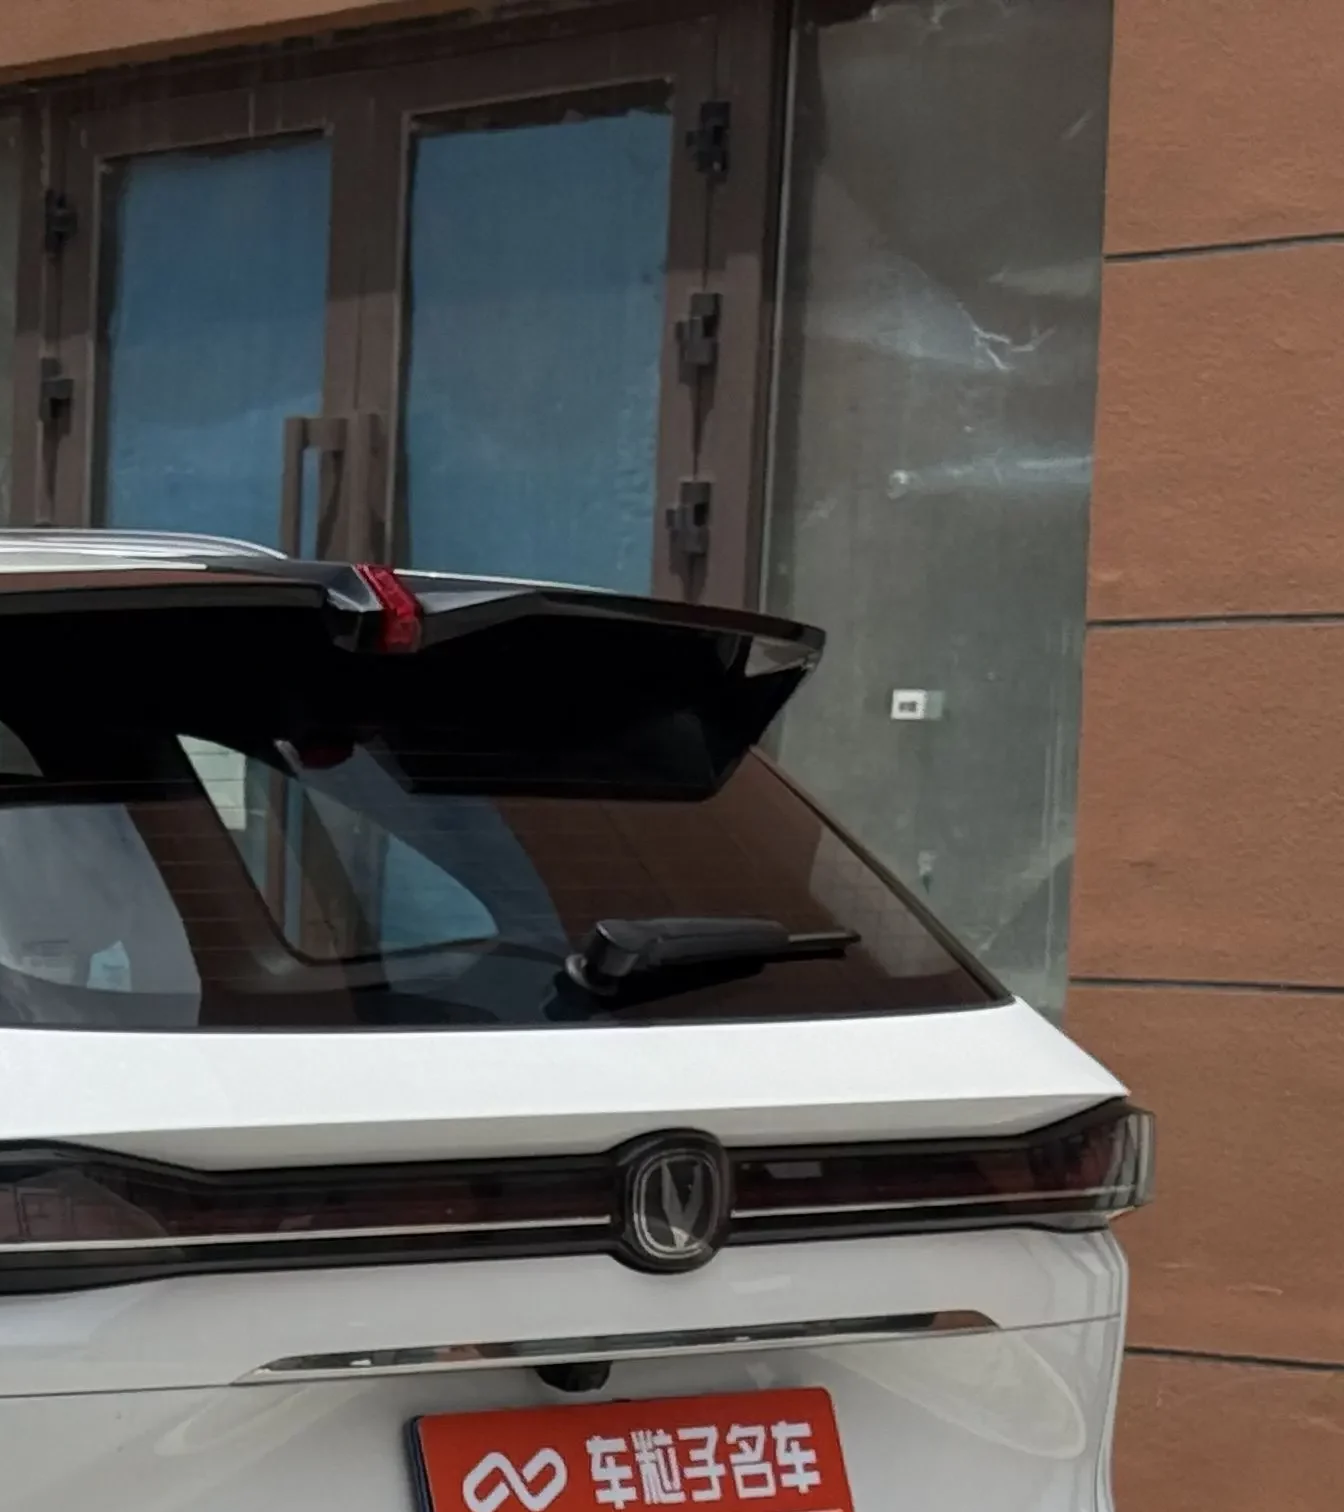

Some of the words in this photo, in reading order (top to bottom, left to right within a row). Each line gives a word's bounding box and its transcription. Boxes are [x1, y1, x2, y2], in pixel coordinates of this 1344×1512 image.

[585, 1420, 821, 1510] 车粒子名车
